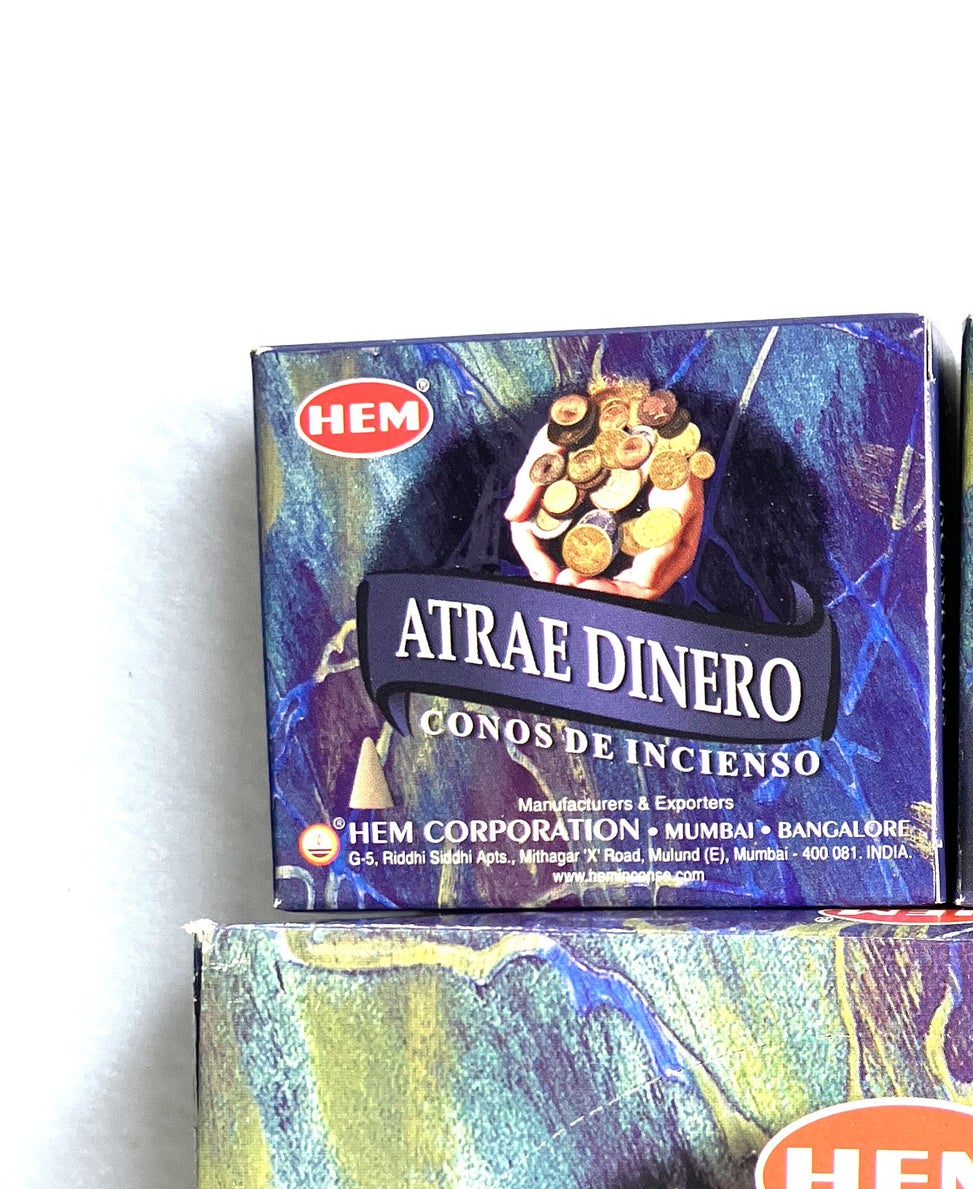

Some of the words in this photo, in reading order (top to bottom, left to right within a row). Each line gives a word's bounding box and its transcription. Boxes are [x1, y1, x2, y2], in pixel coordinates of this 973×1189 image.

[308, 400, 420, 436] HEM
[395, 597, 571, 683] ATRAE
[582, 625, 802, 723] DINERO
[420, 709, 553, 749] CONOS
[564, 727, 614, 760] DE
[627, 738, 821, 779] INCIENSO
[518, 797, 633, 813] Manufacturers
[638, 796, 650, 810] &
[655, 795, 734, 812] Exporters
[349, 821, 414, 845] HEM
[423, 817, 640, 844] CORPORATION
[665, 822, 754, 840] MUMBAI
[778, 819, 911, 839] BANGALORE
[349, 853, 379, 866] G-5,
[383, 851, 426, 865] Riddhi
[430, 850, 473, 864] Siddhi
[477, 850, 516, 866] Apts.,
[520, 848, 580, 866] Mithagar
[604, 848, 645, 864] Road,
[650, 847, 700, 863] Mulund
[704, 847, 730, 865] (E),
[734, 846, 789, 862] Mumbai
[802, 846, 829, 860] 400
[832, 846, 863, 860] 081.
[866, 843, 913, 860] INDIA.
